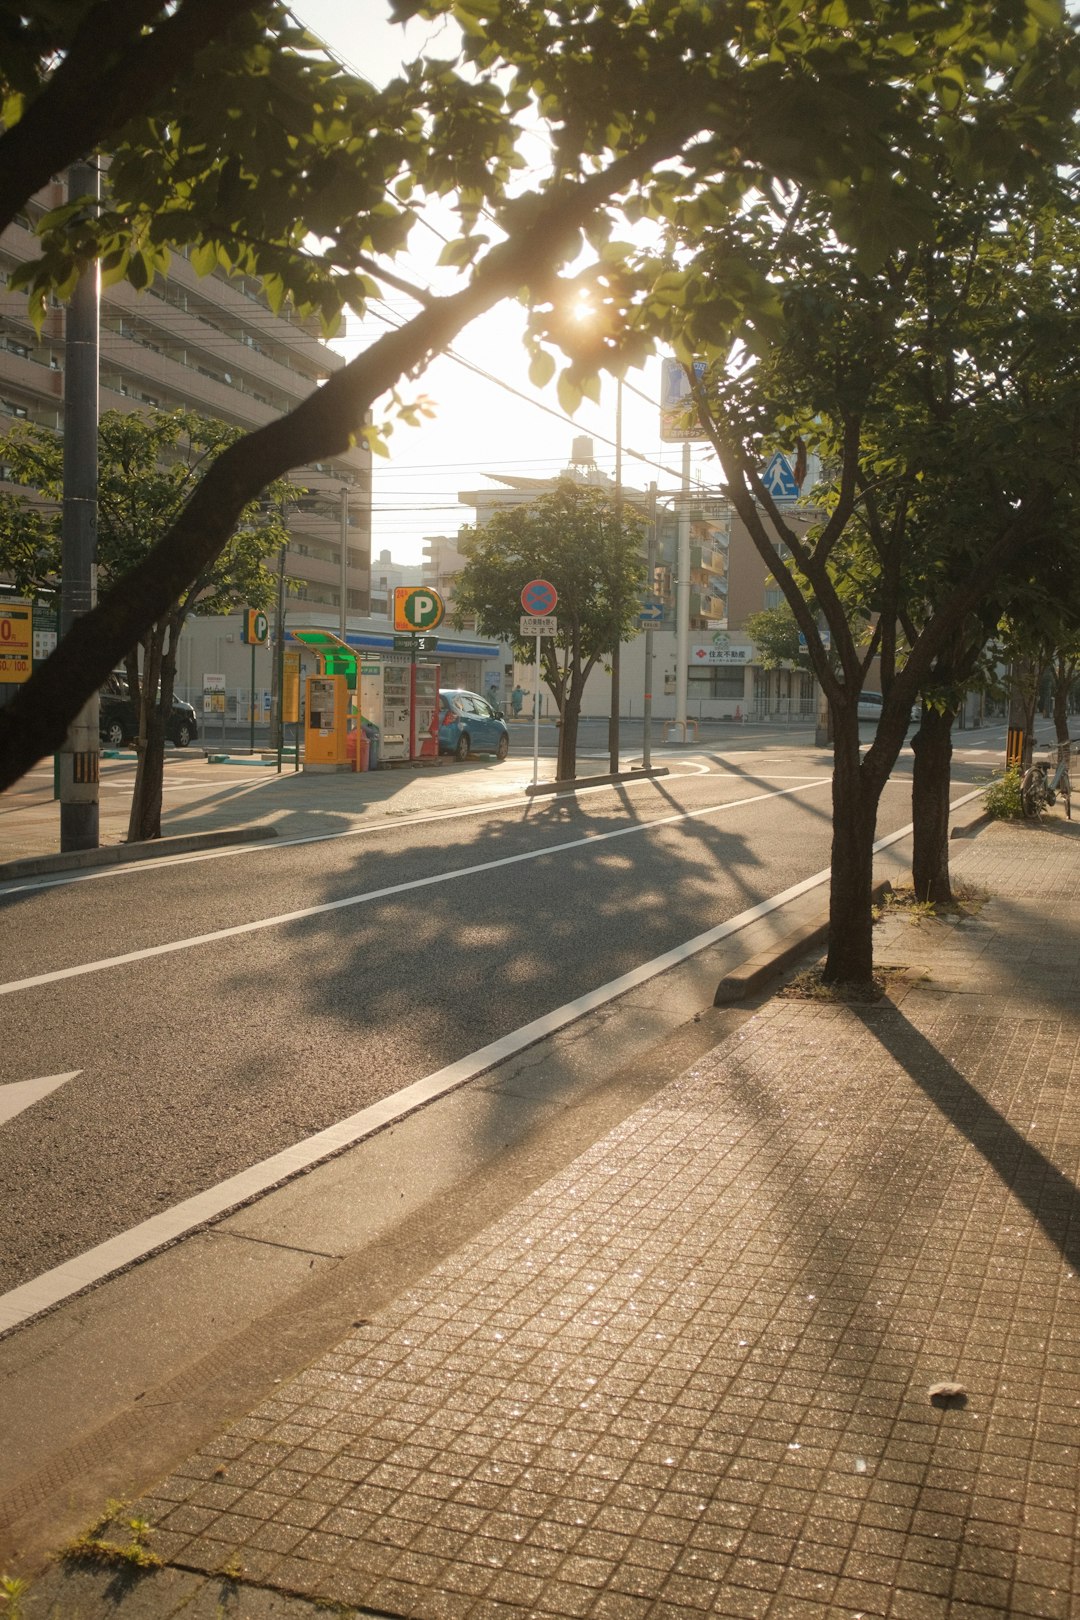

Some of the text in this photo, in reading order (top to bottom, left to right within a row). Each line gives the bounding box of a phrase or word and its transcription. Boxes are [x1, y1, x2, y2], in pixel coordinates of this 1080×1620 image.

[414, 596, 434, 623] P
[258, 617, 266, 638] P
[522, 627, 554, 635] ここまで
[709, 650, 746, 658] 住友不動産
